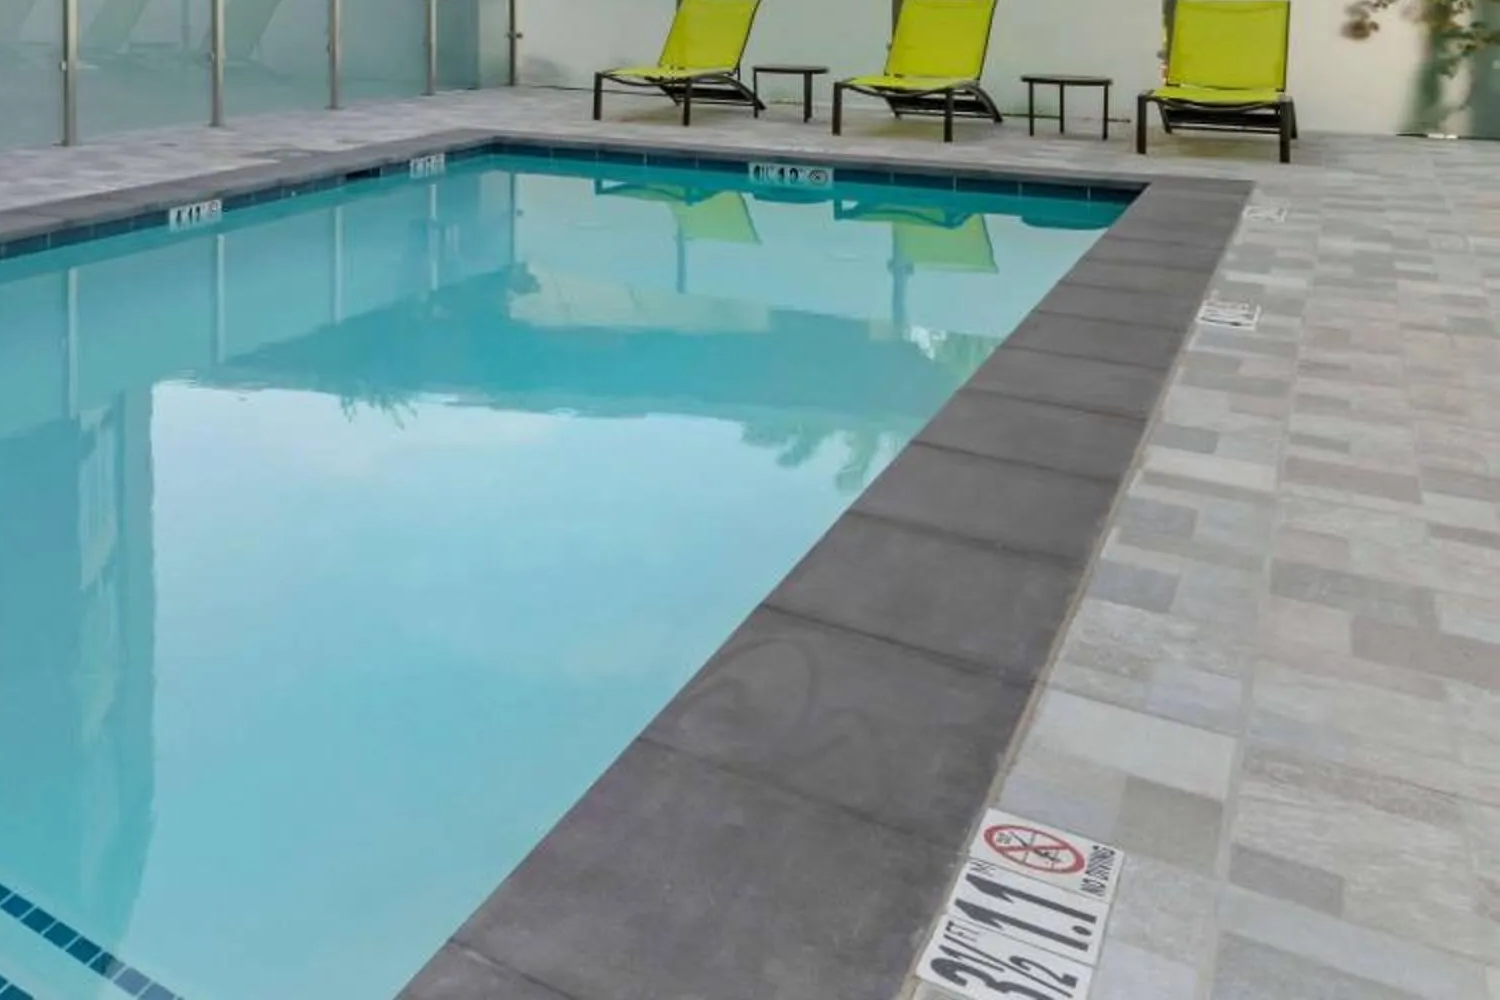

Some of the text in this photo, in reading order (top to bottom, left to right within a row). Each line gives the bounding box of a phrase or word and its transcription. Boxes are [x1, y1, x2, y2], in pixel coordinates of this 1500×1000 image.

[1081, 845, 1115, 897] NO DIVING
[946, 921, 980, 943] FT
[954, 873, 1097, 953] 1.1
